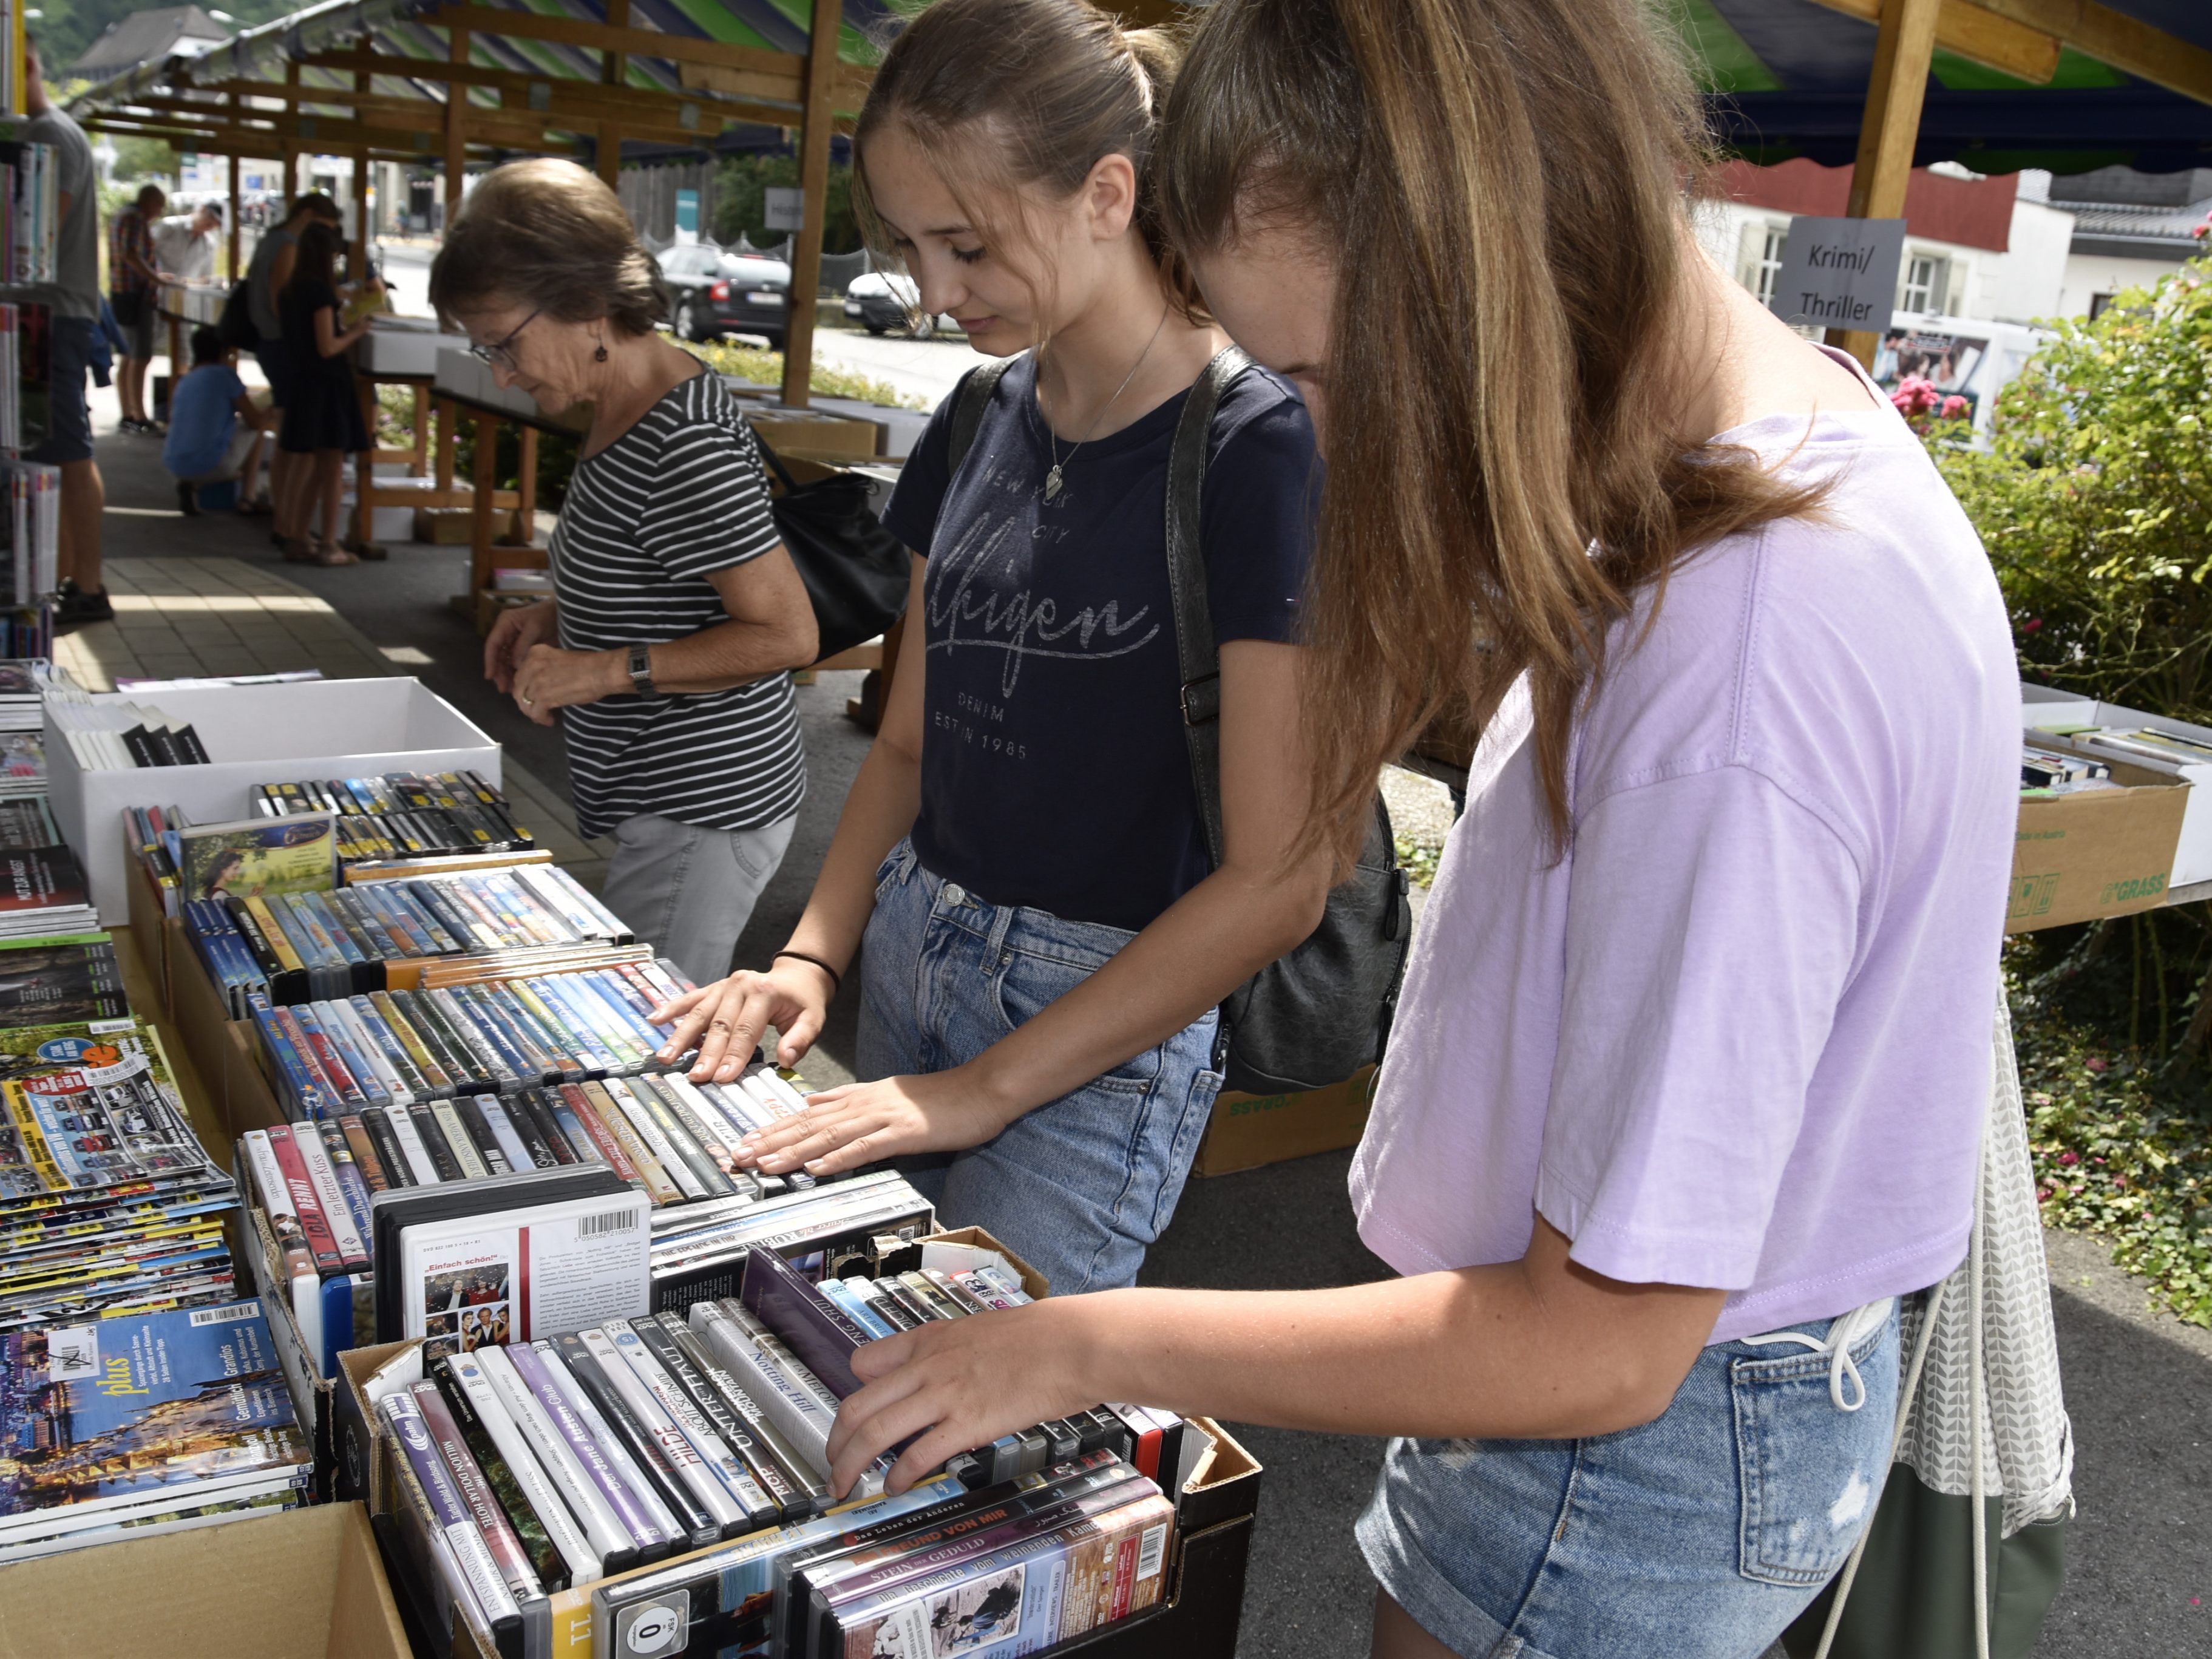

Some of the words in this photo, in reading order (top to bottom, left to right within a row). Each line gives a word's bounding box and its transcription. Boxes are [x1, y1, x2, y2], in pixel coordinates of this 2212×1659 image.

[1808, 244, 1876, 274] Krimi/
[1800, 292, 1873, 321] Thriller
[983, 469, 1025, 492] NEW
[1032, 524, 1068, 543] CITY
[958, 691, 1005, 722] DENIM
[934, 711, 957, 734] EST
[960, 726, 974, 745] IN
[982, 735, 1026, 761] 1985
[2017, 830, 2034, 841] ade
[9, 860, 27, 877] ANGST
[13, 877, 30, 889] ZUR
[16, 889, 32, 900] MUT
[2116, 874, 2166, 901] GRASS
[678, 1104, 691, 1116] DES
[687, 1116, 702, 1129] TAG
[47, 1133, 64, 1142] VW
[609, 1116, 634, 1142] JESUS
[697, 1130, 711, 1141] DER
[312, 1154, 330, 1175] Kuss
[362, 1155, 381, 1178] Tulpen
[484, 1149, 503, 1161] MAN
[616, 1161, 636, 1176] HAPPY
[288, 1178, 319, 1211] RENNT
[320, 1175, 341, 1204] letzter
[333, 1202, 346, 1216] Ein
[304, 1213, 329, 1239] LOLA
[582, 1232, 607, 1241] 050582
[610, 1227, 635, 1237] 210057
[721, 1235, 739, 1246] DIR
[813, 1298, 845, 1322] SHUI
[857, 1309, 870, 1321] ART
[867, 1320, 889, 1336] BRUT
[132, 1334, 140, 1349] Szene-
[141, 1325, 152, 1347] Kleinseite
[236, 1337, 247, 1360] Kubismus
[246, 1326, 260, 1351] Kunstrebell
[133, 1350, 142, 1363] durch
[147, 1356, 156, 1372] Altstadt
[156, 1338, 168, 1365] Insider-Tipps
[219, 1344, 239, 1377] Grandios
[95, 1357, 150, 1397] plus
[135, 1362, 147, 1388] Spaziergänge
[161, 1365, 169, 1377] Seiten
[659, 1345, 704, 1391] HAUT
[543, 1384, 563, 1405] Club
[653, 1372, 691, 1408] SCHMIDT
[715, 1368, 765, 1420] MOUNTAIN
[748, 1351, 790, 1392] Notting
[787, 1391, 816, 1413] Hill
[228, 1383, 251, 1422] Gemütlich
[252, 1389, 266, 1419] Expeditionen
[264, 1388, 278, 1408] Bierreich
[277, 1430, 289, 1440] Burg
[404, 1420, 422, 1440] palm
[557, 1405, 589, 1443] Austen
[686, 1408, 718, 1437] ABOUT
[697, 1395, 754, 1451] UNTER
[242, 1433, 265, 1466] Glanzvoll
[585, 1444, 607, 1471] Jane
[653, 1424, 702, 1469] HILDE
[426, 1459, 444, 1484] Birdsong
[473, 1475, 486, 1489] THE
[600, 1472, 623, 1492] Der
[759, 1467, 790, 1497] MCP
[441, 1440, 465, 1472] MILLION
[458, 1472, 481, 1504] DOLLAR
[472, 1503, 494, 1529] HOTEL
[438, 1490, 453, 1505] Wald
[446, 1504, 462, 1520] Tiefer
[853, 1528, 873, 1542] Das
[875, 1521, 903, 1535] Leben
[905, 1515, 923, 1527] der
[926, 1501, 965, 1518] Anderen
[449, 1529, 469, 1546] MIT
[881, 1530, 942, 1559] FREUND
[943, 1516, 978, 1536] VON
[979, 1507, 1008, 1525] MIR
[870, 1561, 914, 1583] STEIN
[914, 1557, 928, 1567] DER
[928, 1538, 986, 1564] GEDULD
[878, 1589, 898, 1603] Die
[903, 1567, 966, 1595] Geschichte
[971, 1556, 997, 1573] vom
[1000, 1533, 1064, 1561] weinenden
[1067, 1519, 1099, 1538] Kame
[458, 1545, 501, 1613] ENTSPANNUNG
[1053, 1571, 1062, 1593] TRAILER
[1050, 1595, 1059, 1627] INTERVIEWS
[639, 1623, 662, 1640] 0
